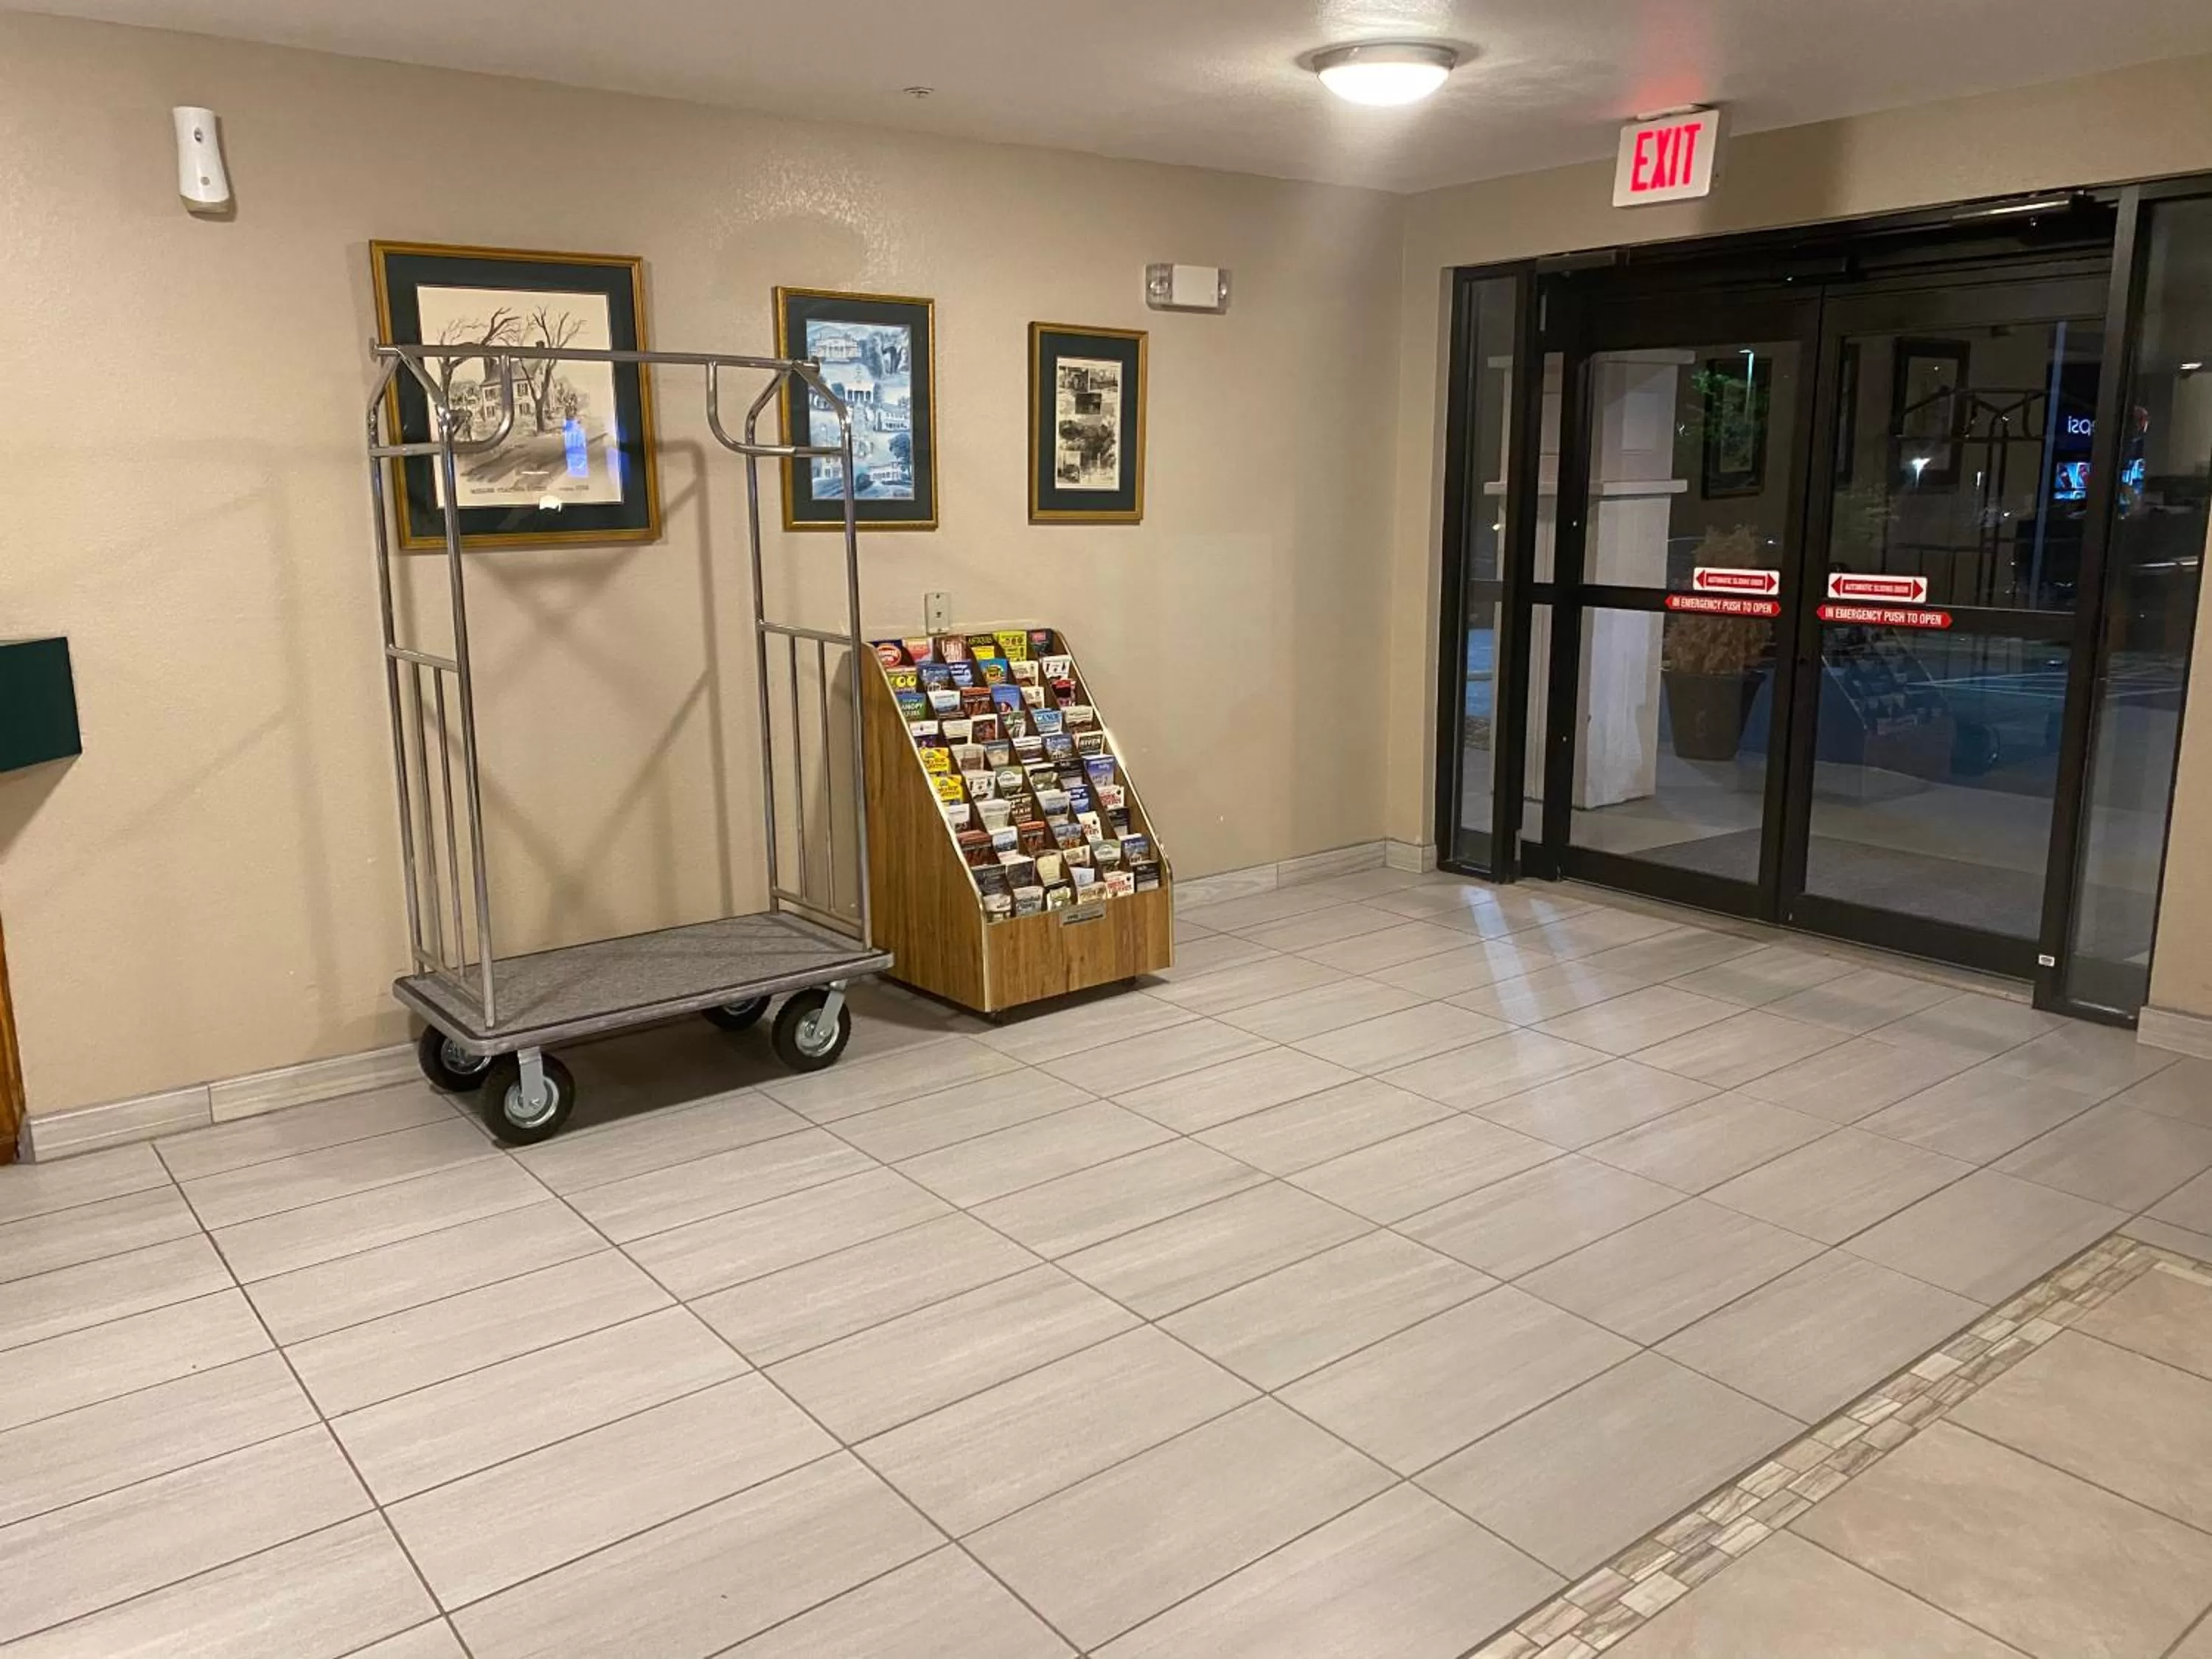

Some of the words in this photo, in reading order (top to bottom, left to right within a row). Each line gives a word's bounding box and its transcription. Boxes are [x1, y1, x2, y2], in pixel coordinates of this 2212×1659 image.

[1630, 122, 1702, 192] EXIT
[1672, 597, 1680, 608] IN
[1680, 597, 1722, 611] EMERGENCY
[1722, 600, 1741, 612] PUSH
[1742, 601, 1753, 613] TO
[1753, 602, 1773, 614] OPEN
[1825, 607, 1834, 618] IN
[1835, 608, 1882, 622] EMERGENCY
[1883, 611, 1905, 623] PUSH
[1907, 612, 1919, 624] TO
[1919, 613, 1942, 626] OPEN
